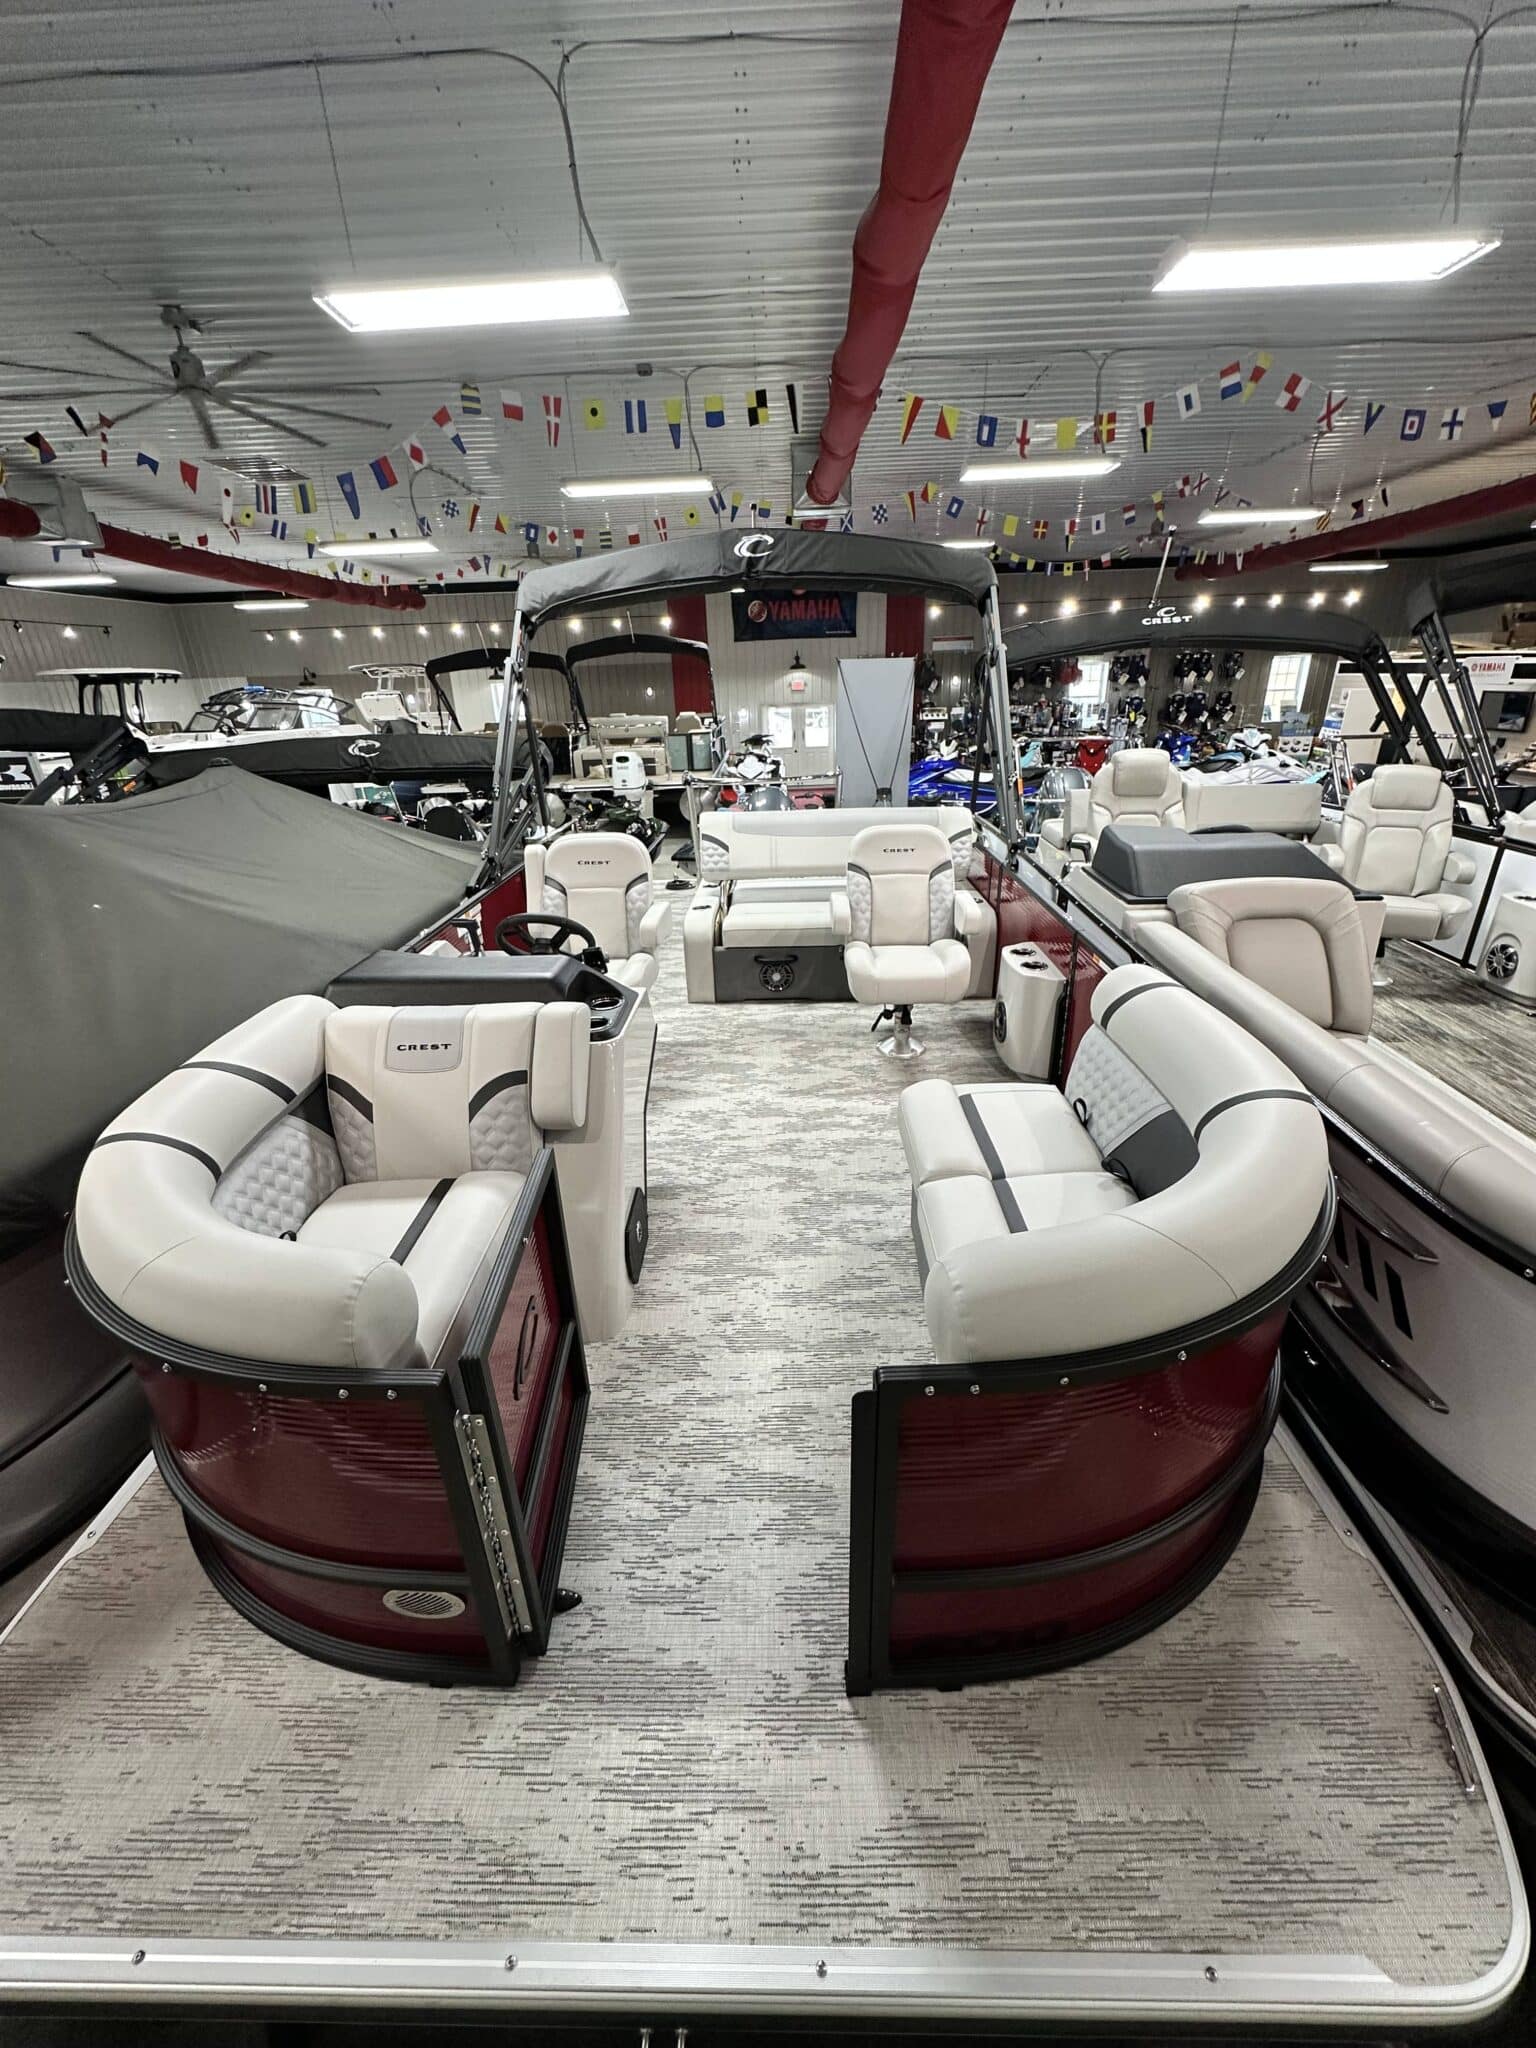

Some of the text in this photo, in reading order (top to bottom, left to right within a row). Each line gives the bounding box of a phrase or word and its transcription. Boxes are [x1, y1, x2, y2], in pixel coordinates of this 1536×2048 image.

[768, 598, 842, 620] YAMAHA
[1141, 615, 1193, 626] CREST
[1478, 662, 1506, 673] YAMAHA
[396, 1043, 453, 1051] CREST
